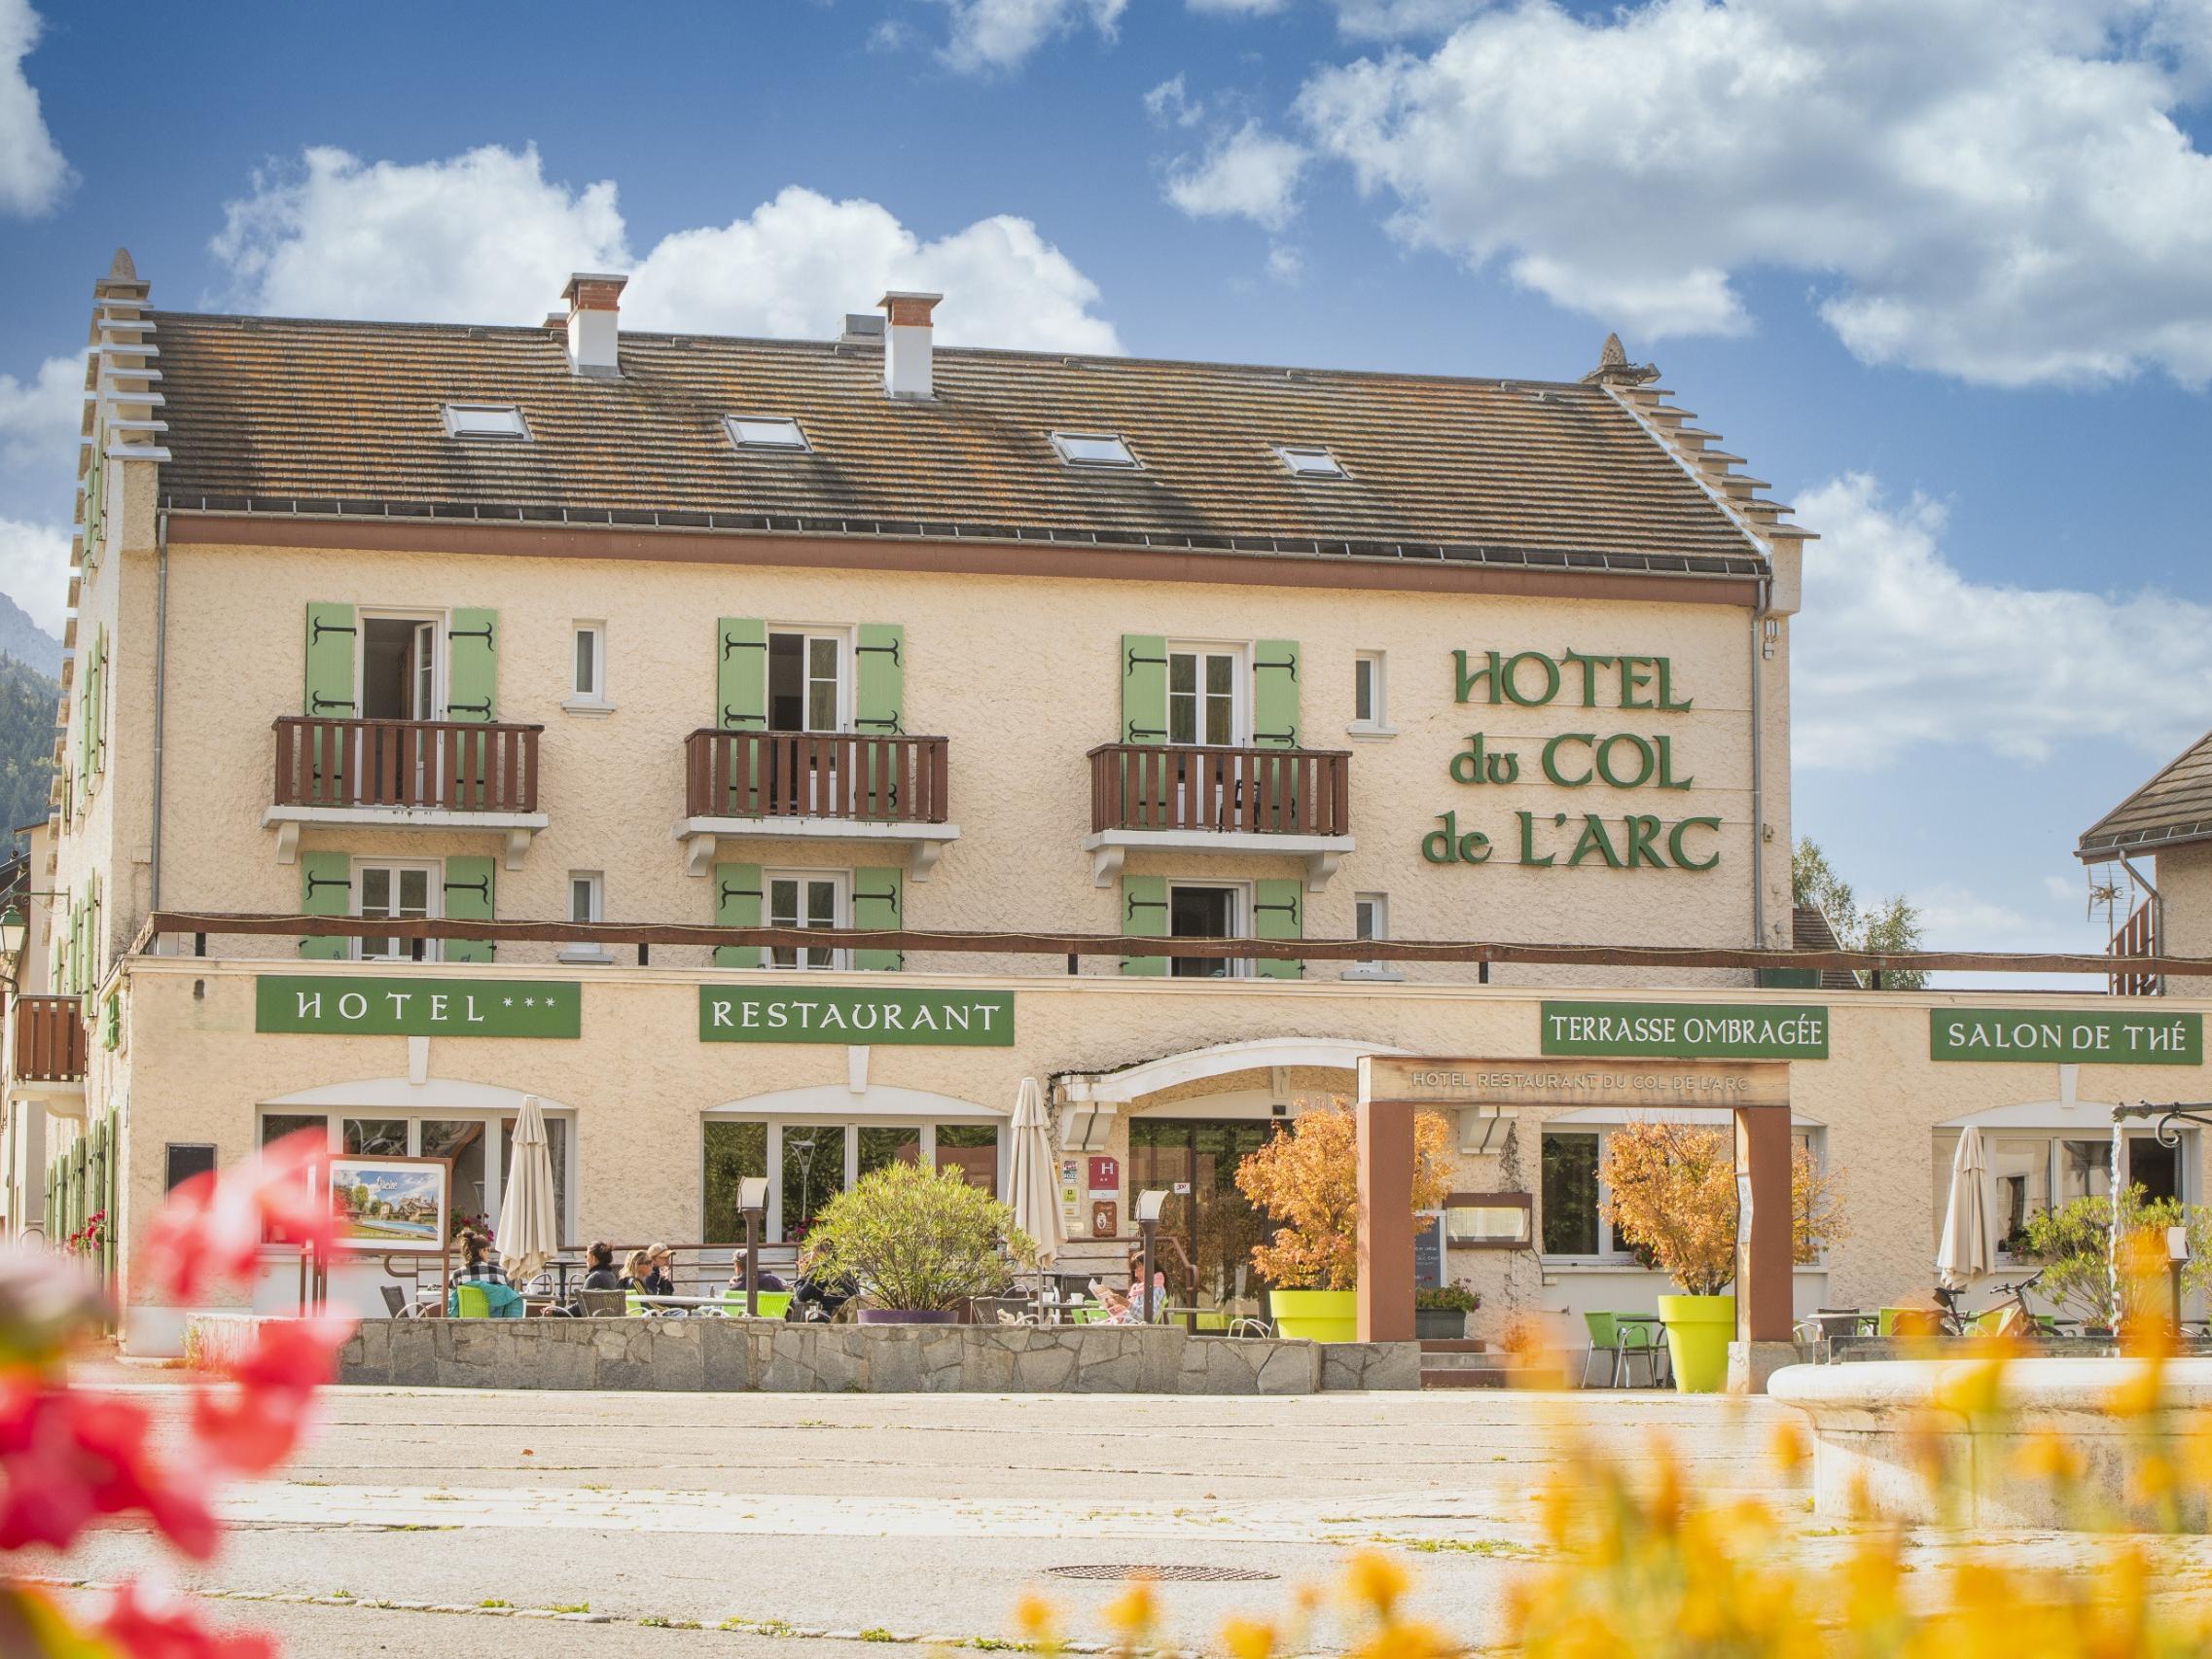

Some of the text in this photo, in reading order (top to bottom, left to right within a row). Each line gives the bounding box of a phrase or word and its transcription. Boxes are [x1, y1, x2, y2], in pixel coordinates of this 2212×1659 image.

[1451, 646, 1694, 713] HOTEL
[1449, 732, 1694, 791] du COL
[1422, 810, 1723, 871] de L'ARC
[296, 991, 484, 1022] HOTEL
[712, 1000, 1001, 1030] RESTAURANT
[1550, 1014, 1822, 1045] TERRASSE OMBRAGÉE
[1948, 1021, 2186, 1051] SALON DE THÉ
[1412, 1072, 1749, 1091] HOTEL RESTAURANT DU COL DE L'ARC
[1101, 1162, 1114, 1175] H
